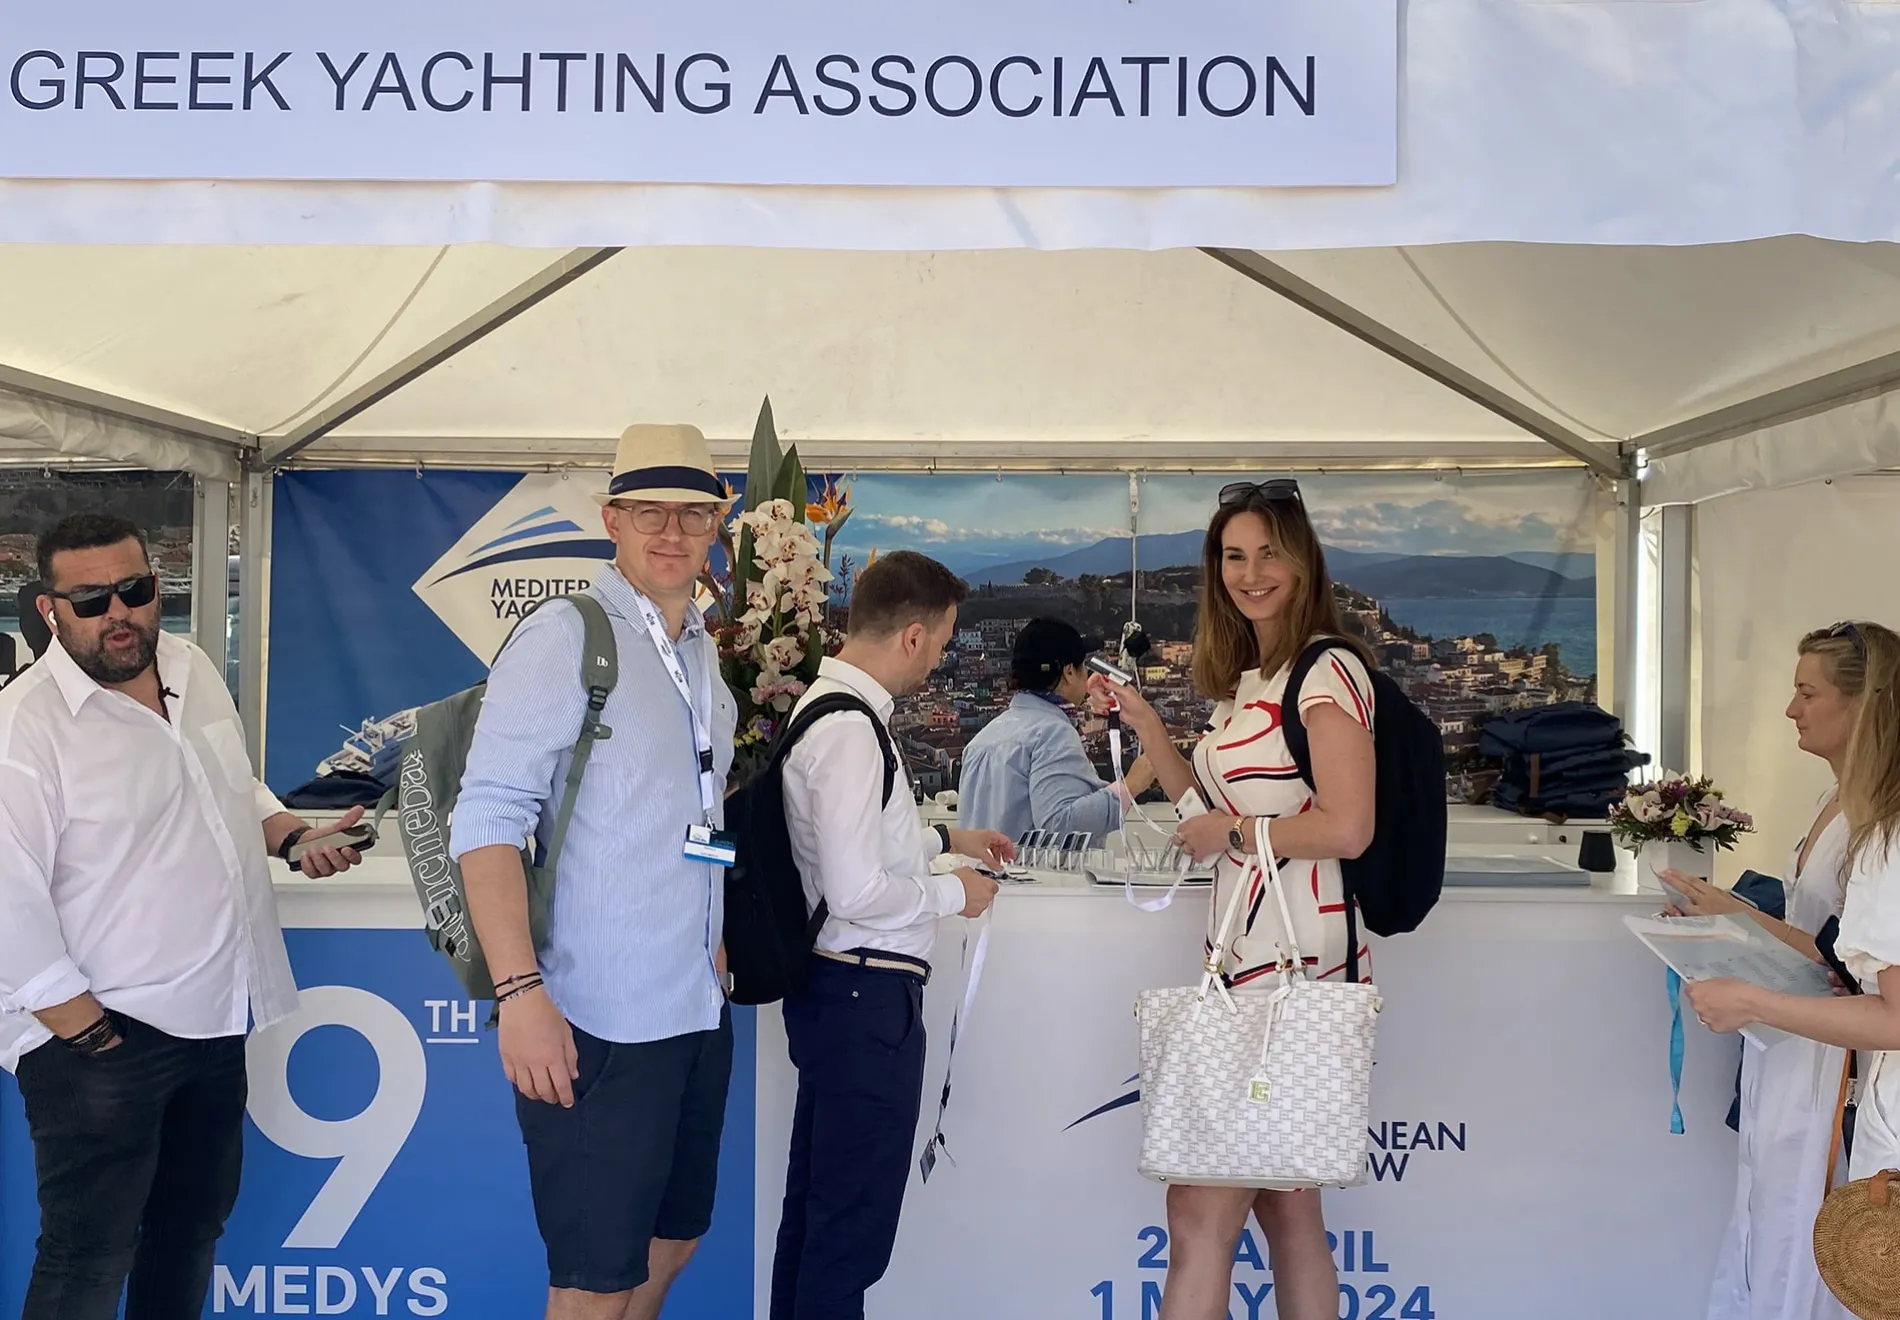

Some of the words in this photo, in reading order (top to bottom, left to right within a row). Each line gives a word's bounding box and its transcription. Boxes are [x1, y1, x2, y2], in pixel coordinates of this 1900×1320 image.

[10, 49, 293, 111] GREEK
[316, 51, 731, 115] YACHTING
[753, 54, 1316, 118] ASSOCIATION
[491, 600, 537, 619] YAC
[213, 1265, 448, 1317] MEDYS
